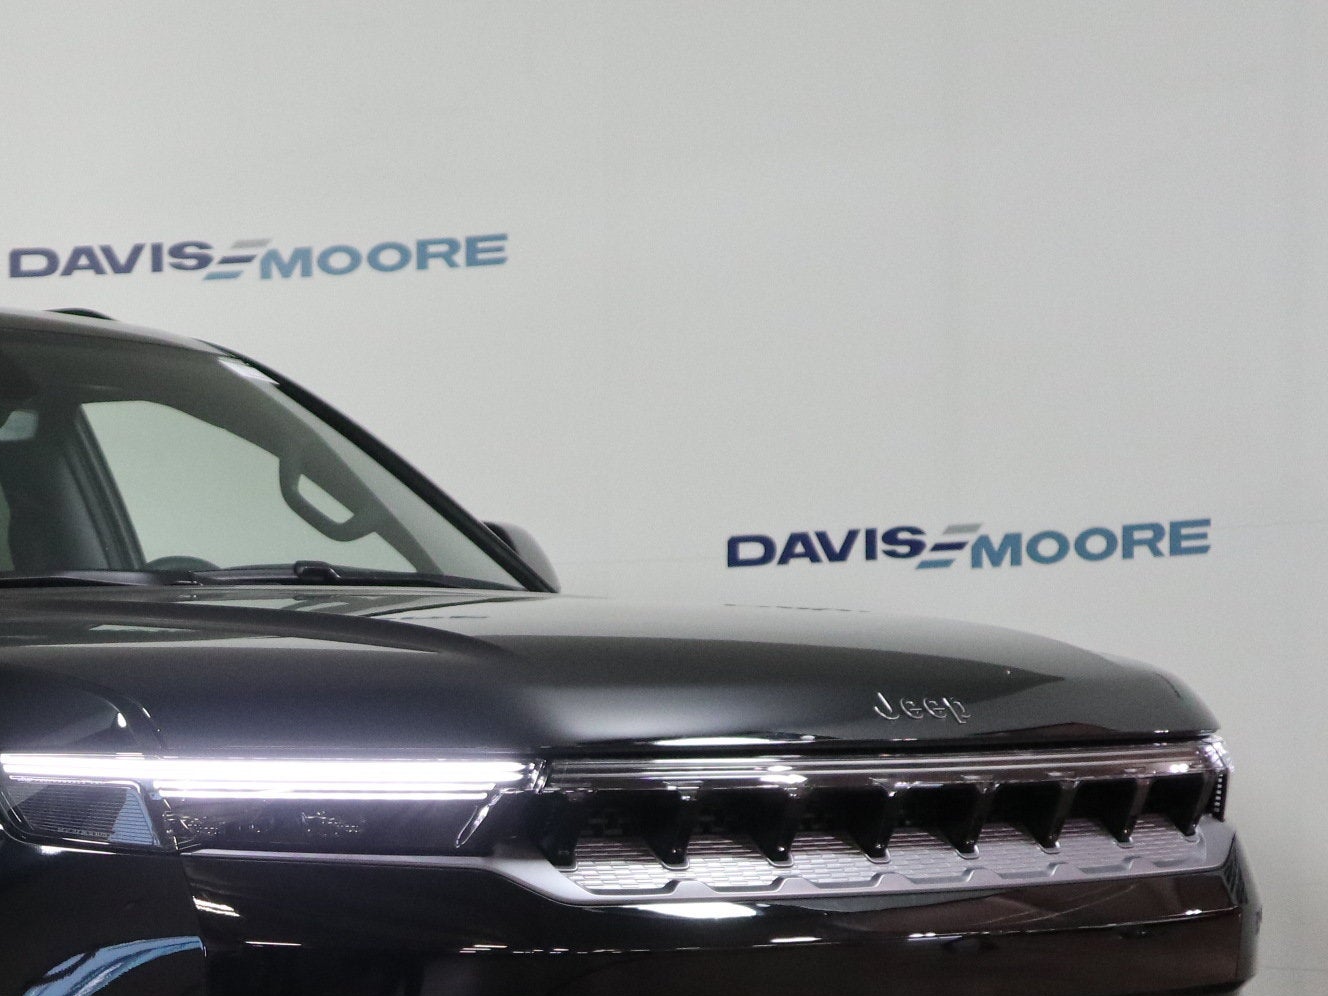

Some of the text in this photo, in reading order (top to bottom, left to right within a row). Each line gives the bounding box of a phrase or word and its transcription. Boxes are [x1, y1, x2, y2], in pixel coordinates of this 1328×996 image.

[8, 233, 509, 280] DAVIS MOORE
[727, 518, 1211, 569] DAVIS MOORE
[874, 692, 971, 723] Jeep
